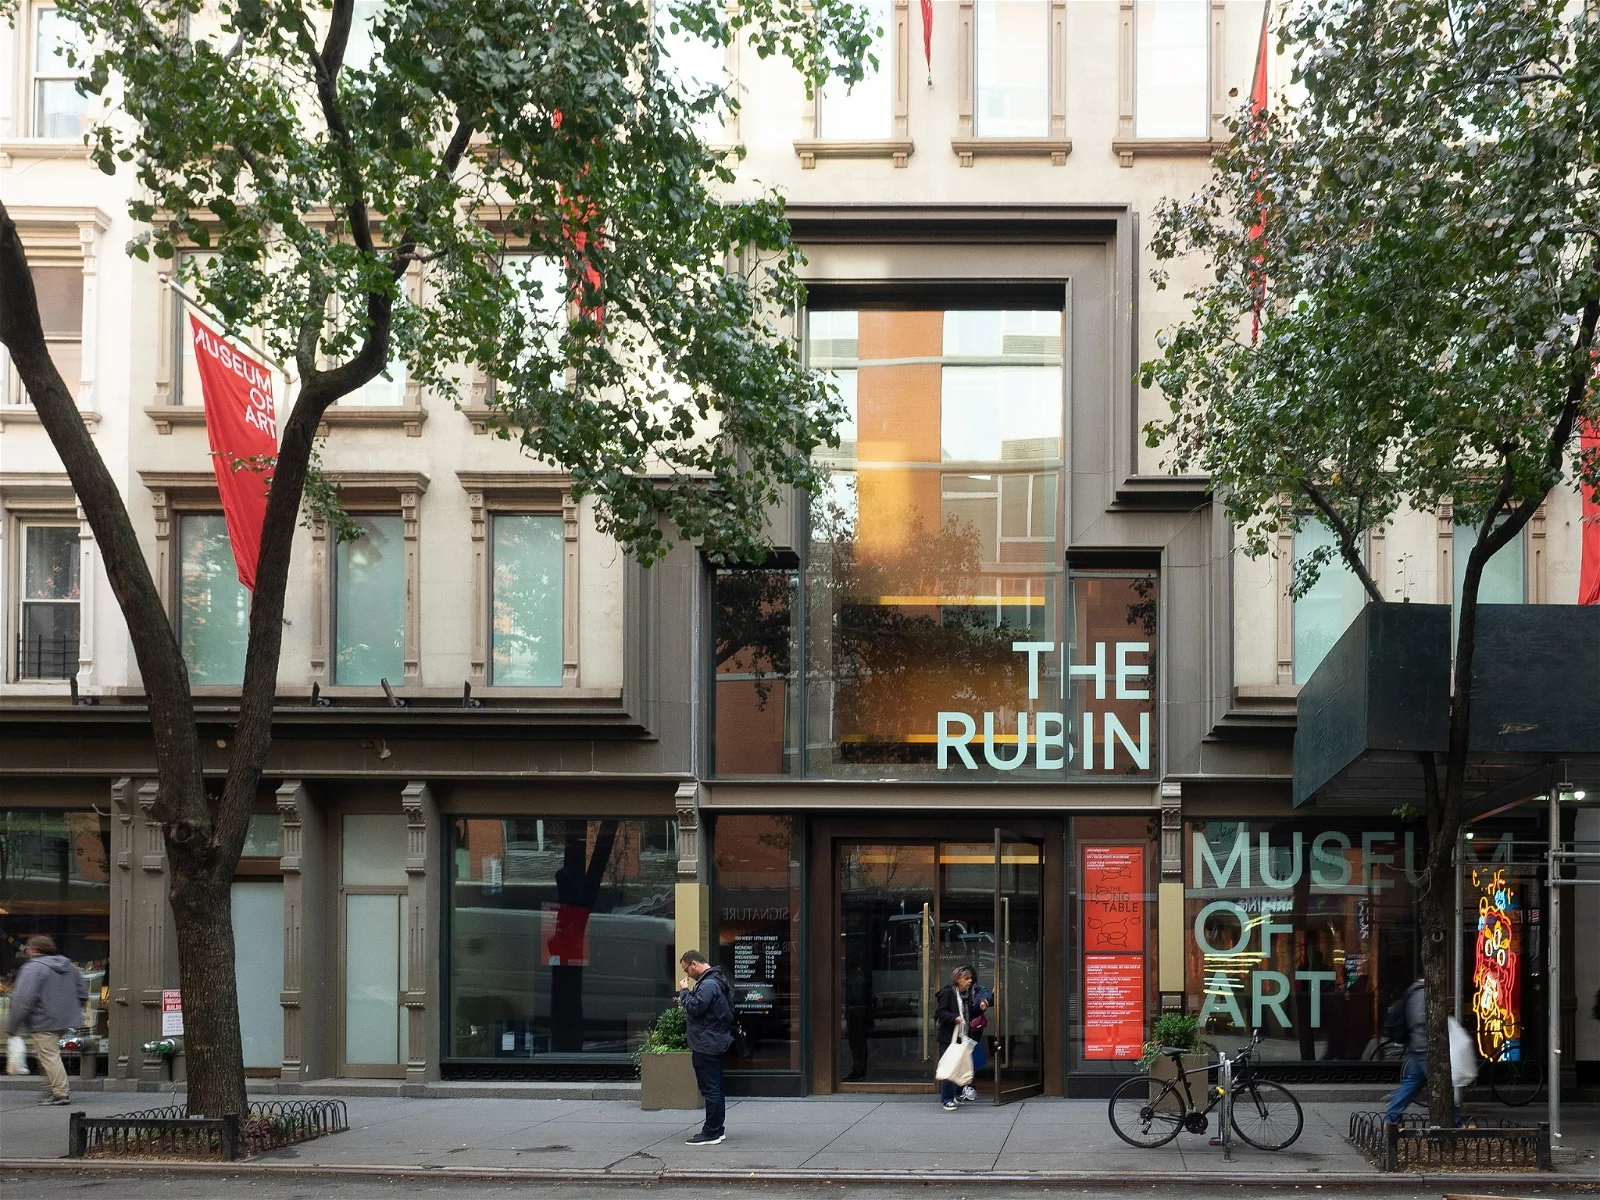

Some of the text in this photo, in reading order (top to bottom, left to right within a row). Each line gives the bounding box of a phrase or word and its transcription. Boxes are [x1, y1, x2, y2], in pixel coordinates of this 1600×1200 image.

[245, 405, 276, 439] ART
[249, 387, 274, 414] OF
[1012, 641, 1150, 700] THE
[937, 711, 1150, 771] RUBIN
[1103, 902, 1139, 912] TABLE
[1194, 900, 1293, 958] OF
[1199, 970, 1337, 1028] ART
